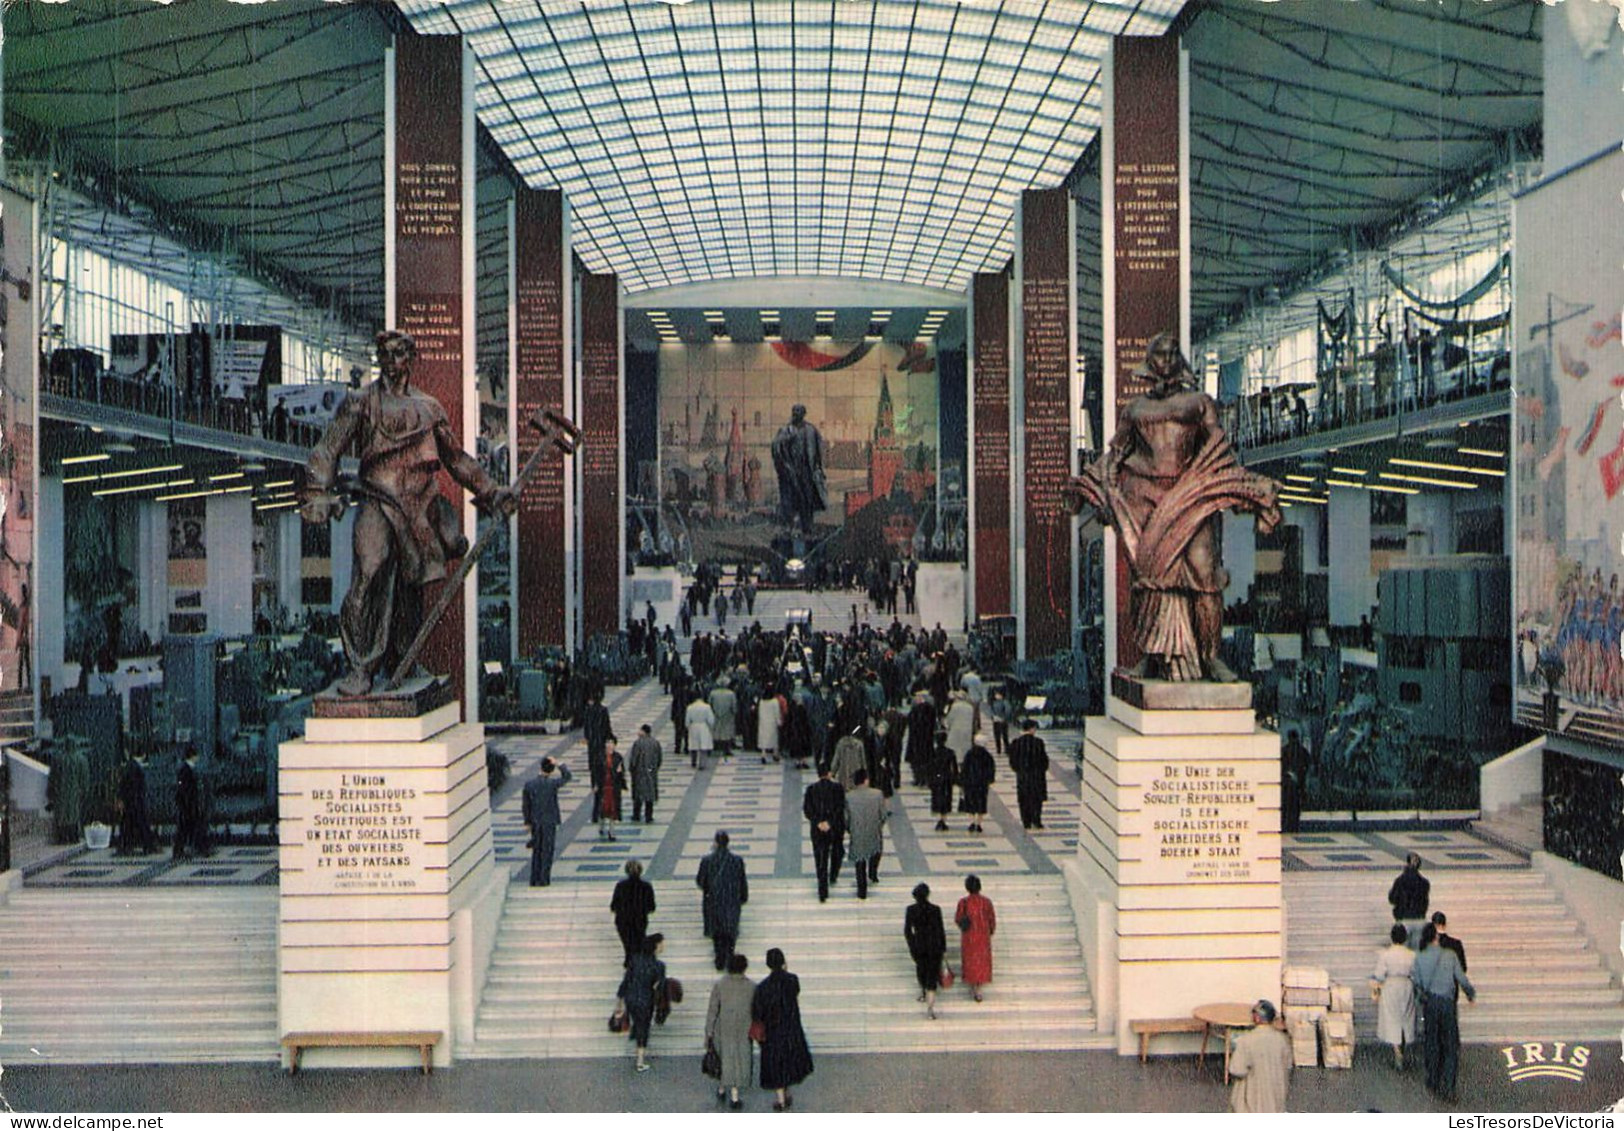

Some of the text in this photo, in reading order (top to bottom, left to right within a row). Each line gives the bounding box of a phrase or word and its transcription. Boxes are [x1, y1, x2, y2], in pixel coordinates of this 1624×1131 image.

[1136, 189, 1157, 197] POUR
[1136, 238, 1157, 246] POUR
[1216, 767, 1235, 777] DER
[1152, 779, 1250, 791] SOCIALISTISCHE
[312, 789, 334, 800] DES
[326, 801, 402, 813] SOCIALISTES
[1180, 807, 1219, 817] IS EEN
[393, 815, 413, 825] EST
[1153, 821, 1250, 830] SOCIALISTISCHE
[306, 828, 422, 840] UN ETAT SOCIALISTE
[1161, 833, 1241, 844] ARBEIDERS EN
[322, 842, 404, 854] DES OUVRIERS
[1160, 847, 1241, 857] BOEREN STAAT
[317, 856, 411, 867] ET DES PAYSANS
